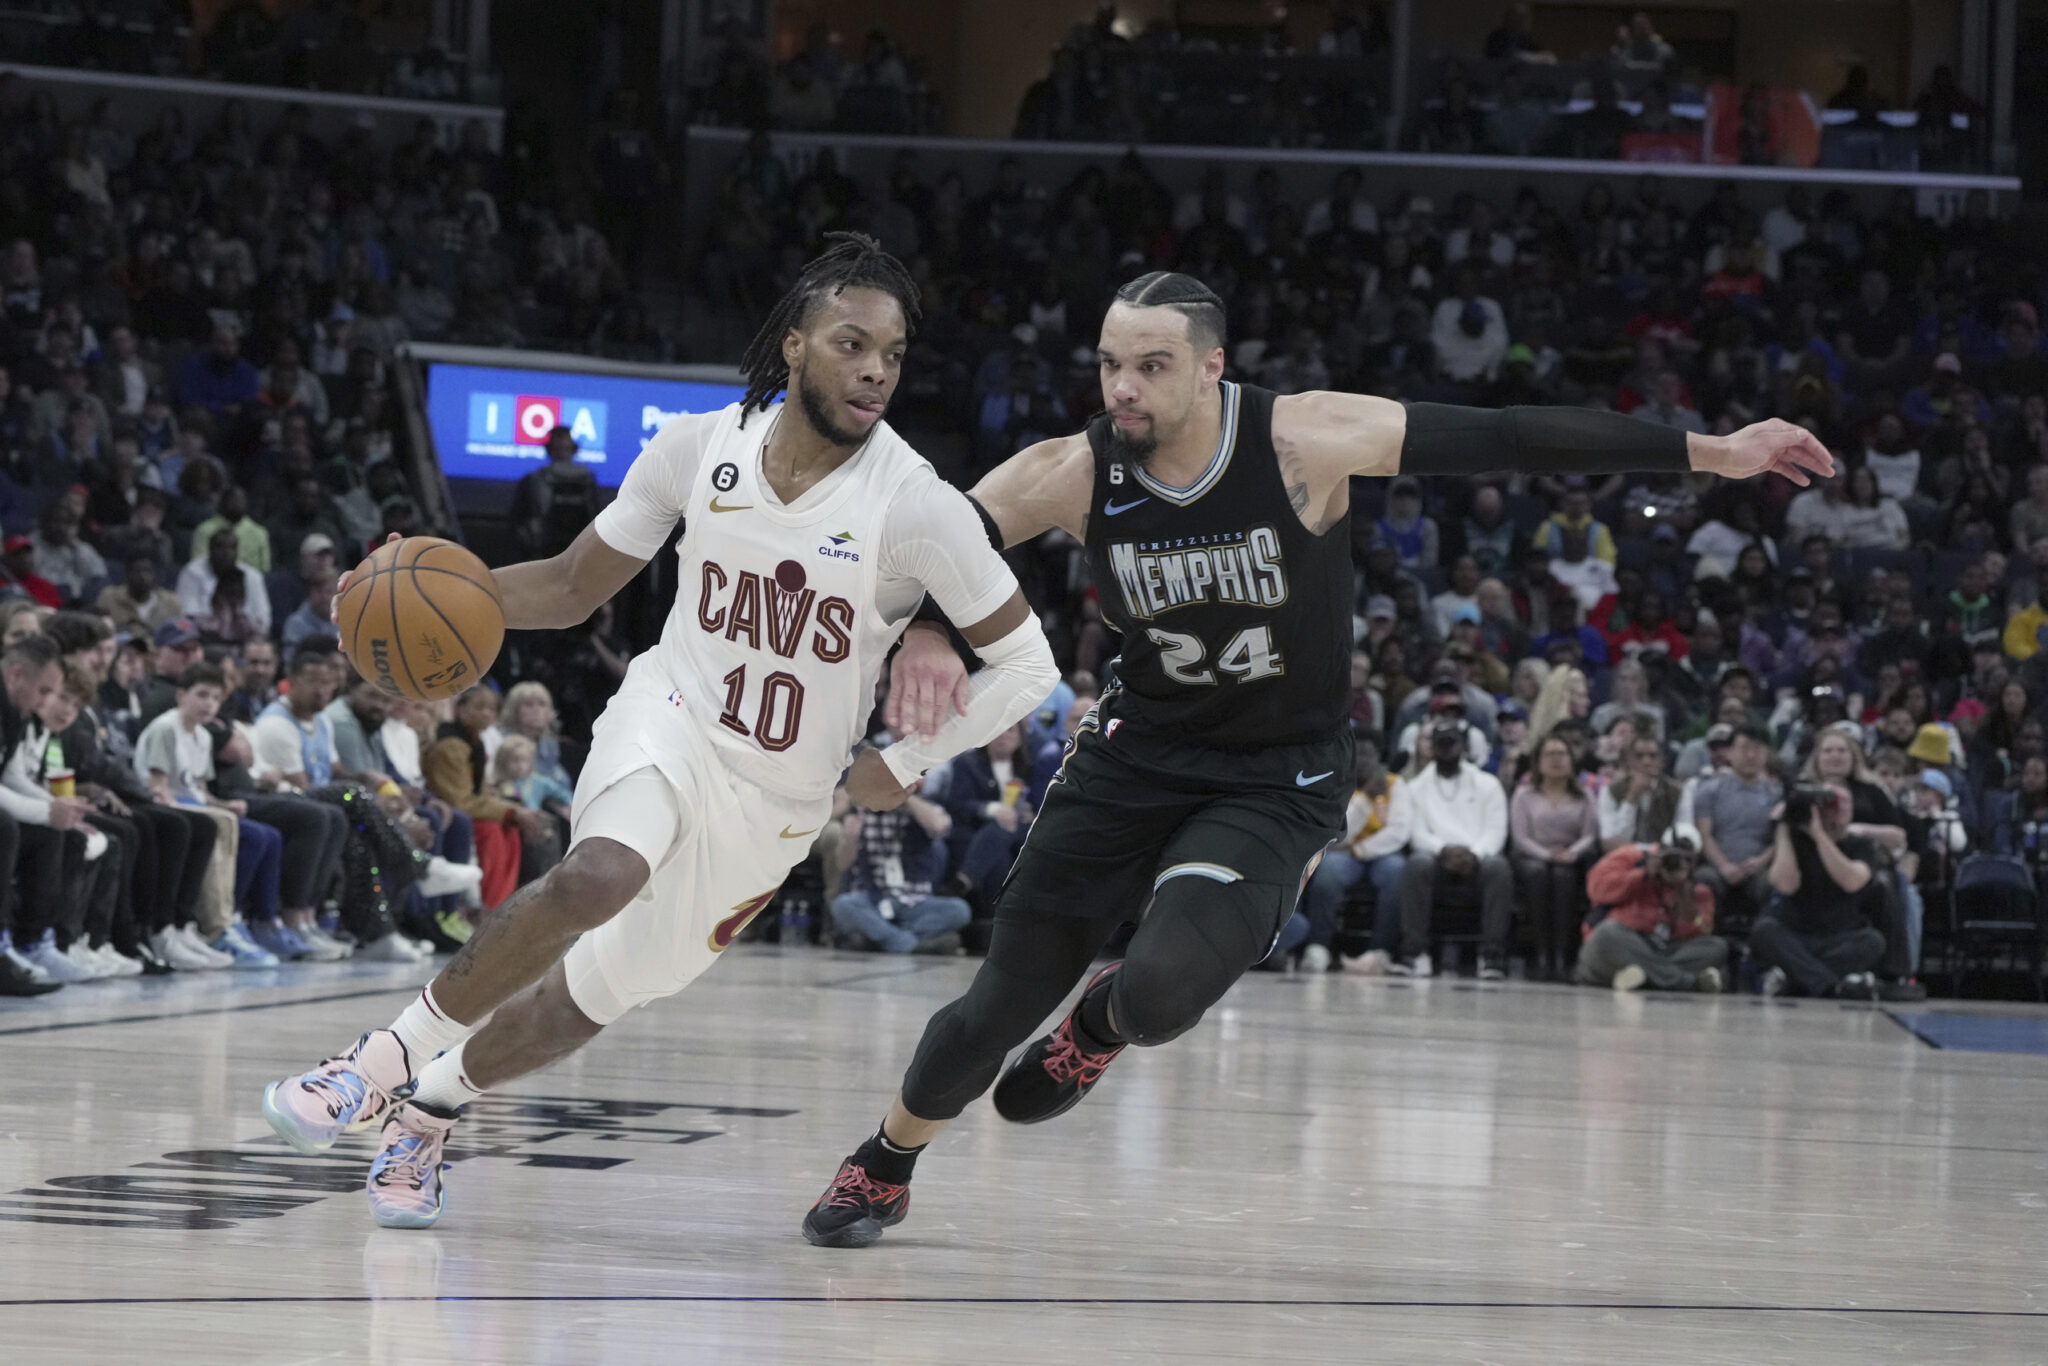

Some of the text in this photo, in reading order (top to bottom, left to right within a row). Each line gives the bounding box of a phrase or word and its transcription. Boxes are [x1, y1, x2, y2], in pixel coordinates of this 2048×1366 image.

[716, 466, 735, 489] 6
[1109, 464, 1124, 485] 6
[818, 546, 860, 562] CLIFFS
[1139, 532, 1243, 551] GRIZZLIES
[1109, 525, 1288, 619] MEMPHIS
[698, 559, 855, 664] CAVS
[1145, 624, 1284, 686] 24
[719, 663, 805, 752] 10
